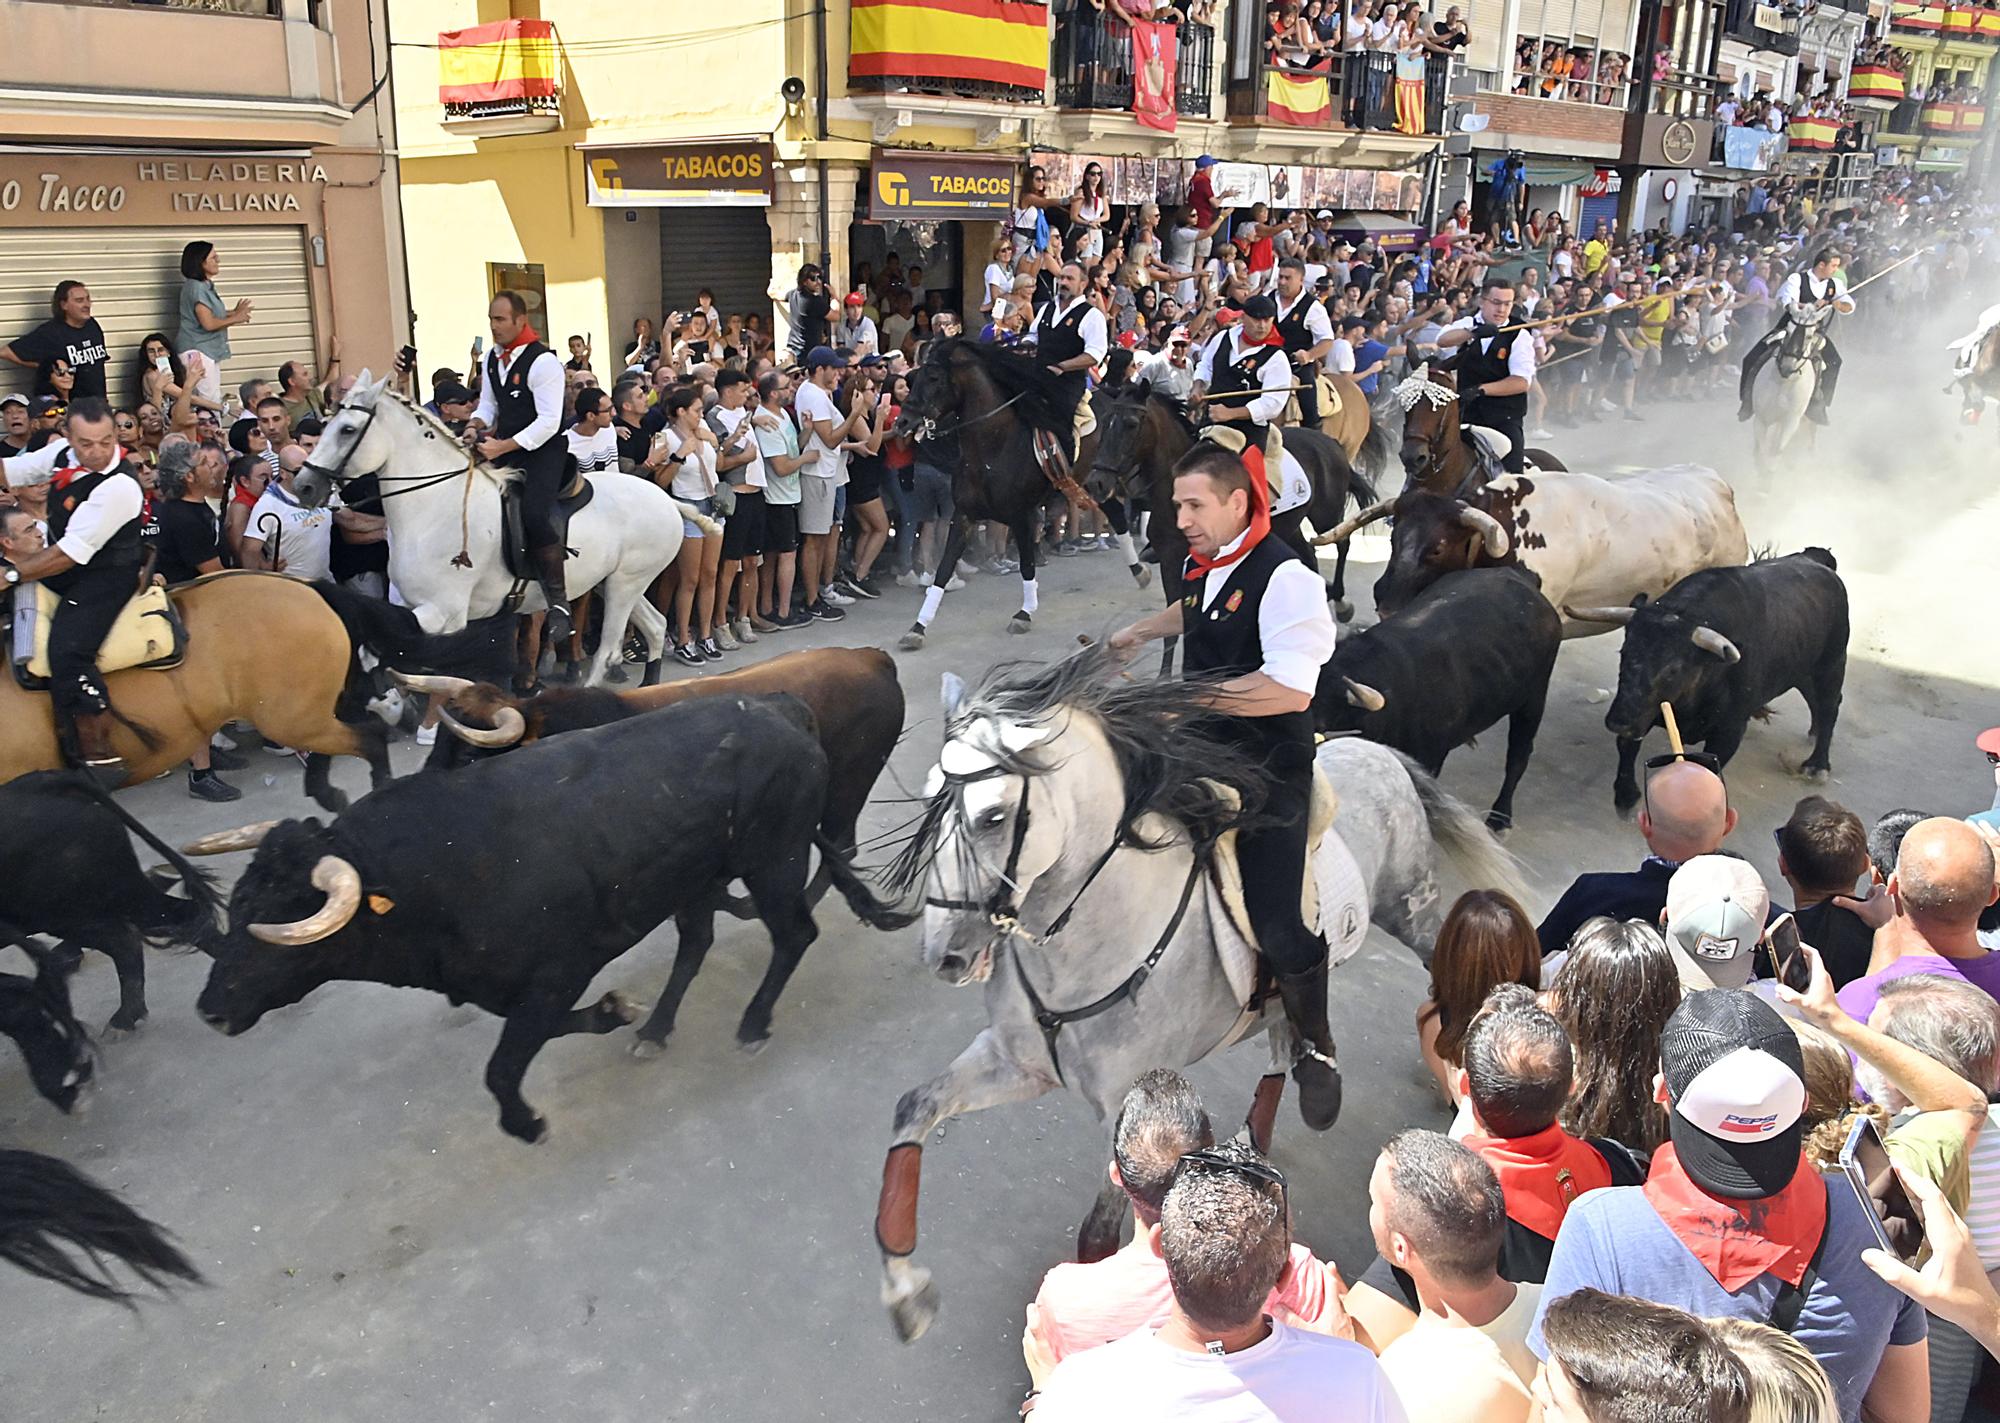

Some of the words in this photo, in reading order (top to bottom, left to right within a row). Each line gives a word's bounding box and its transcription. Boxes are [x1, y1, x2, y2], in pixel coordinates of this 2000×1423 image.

[138, 162, 329, 182] HELADERIA
[662, 153, 763, 179] TABACOS
[930, 175, 1011, 195] TABACOS
[172, 192, 301, 212] ITALIANA
[66, 344, 106, 366] BEATLES
[1725, 1113, 1778, 1124] PEPSI
